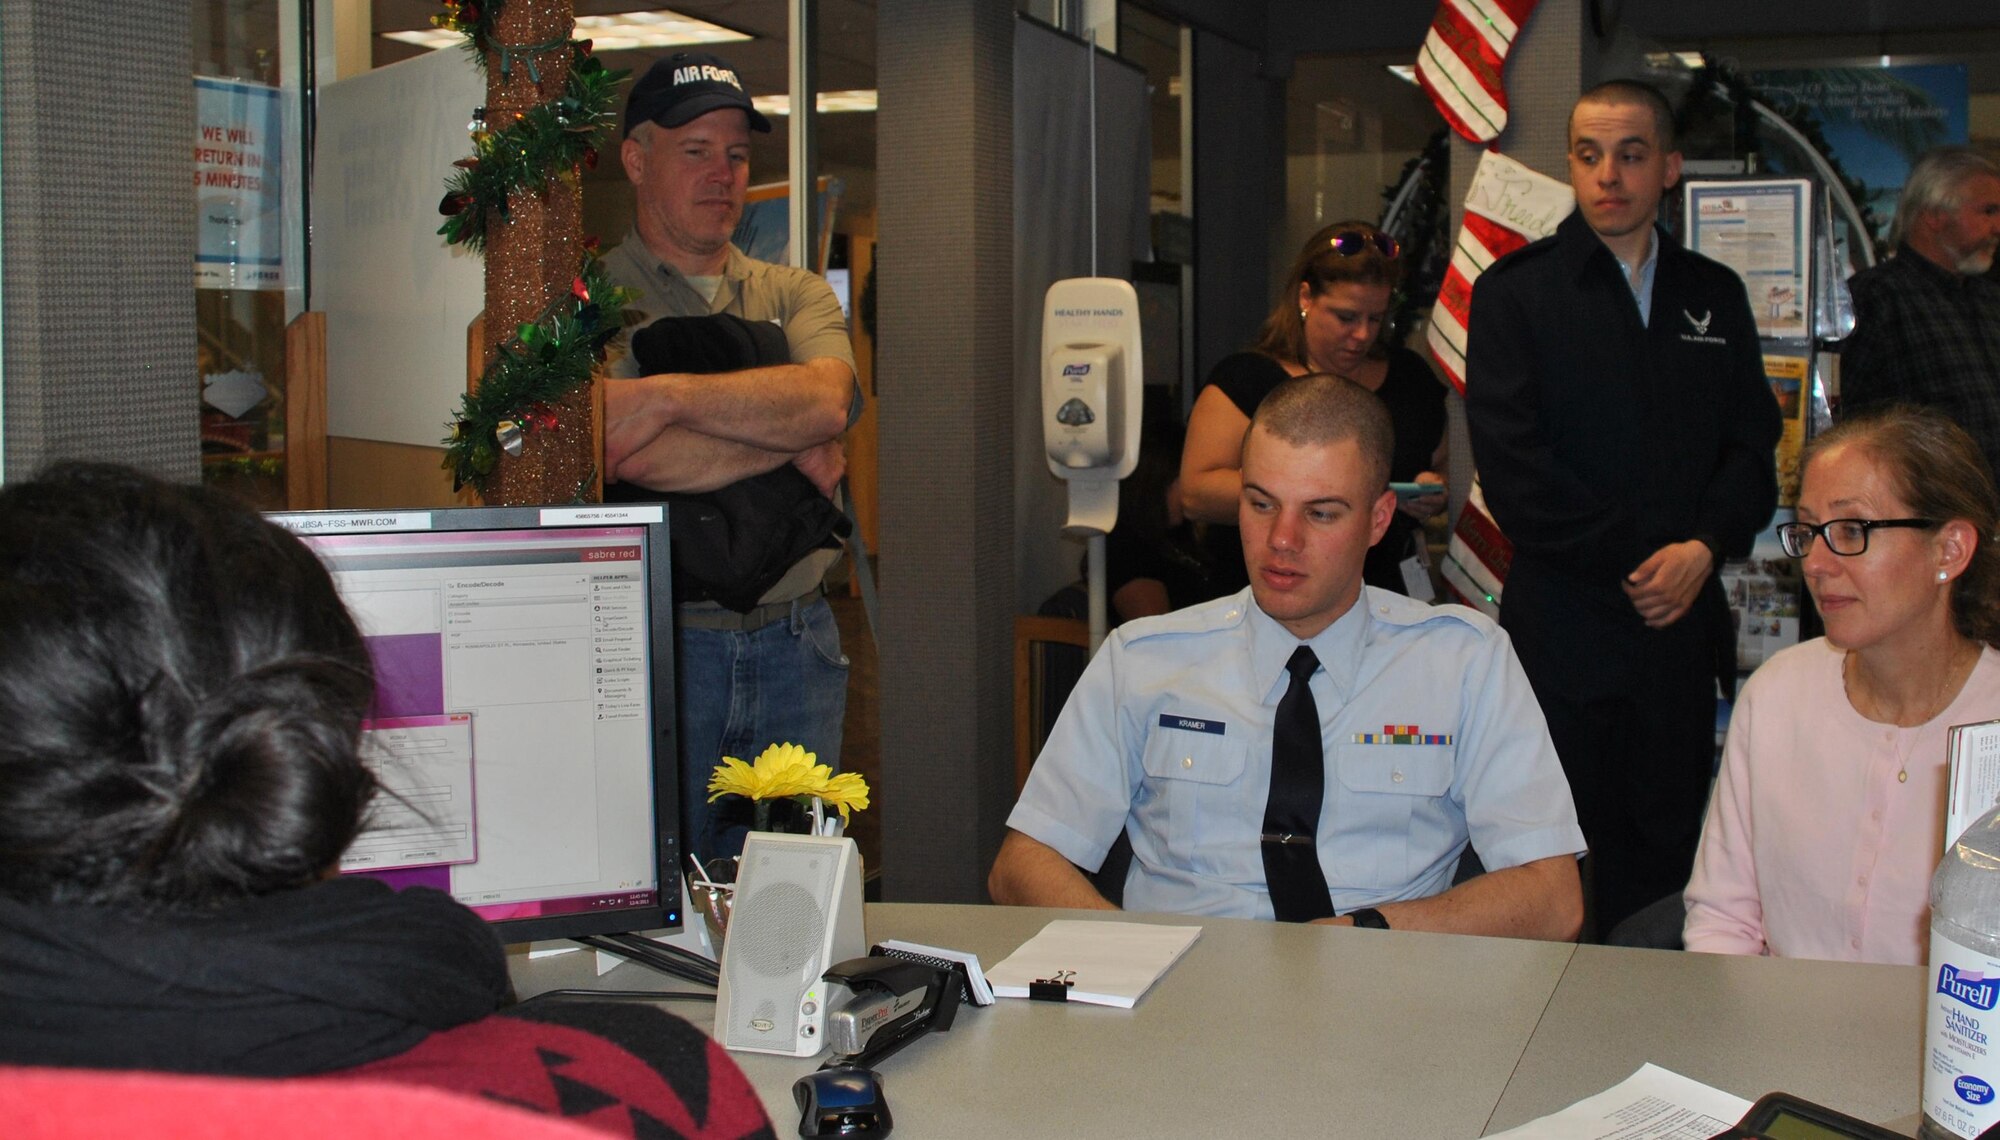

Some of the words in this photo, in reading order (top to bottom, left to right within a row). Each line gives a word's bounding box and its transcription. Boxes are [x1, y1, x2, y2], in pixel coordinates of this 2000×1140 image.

[673, 65, 701, 86] AIR
[701, 65, 743, 92] FORC
[202, 125, 221, 142] WE
[226, 128, 255, 146] WILL
[194, 148, 243, 167] RETURN
[247, 153, 261, 168] IN
[194, 171, 201, 186] 5
[205, 172, 262, 191] MINUTES
[1054, 309, 1090, 317] HEALTHY
[1093, 309, 1123, 317] HANDS
[588, 550, 616, 559] sabre
[619, 549, 636, 558] red
[457, 581, 505, 589] Encode/Decode
[1179, 719, 1206, 730] KRAMER
[1941, 966, 1992, 1008] Purell
[1952, 1007, 1980, 1030] HAND
[1945, 1015, 1988, 1045] SANITIZER
[1949, 1032, 1987, 1056] MOISTURIZERS
[1957, 1078, 1990, 1096] Economy
[1966, 1090, 1981, 1102] Size
[1934, 1105, 1947, 1122] 67.6
[1947, 1113, 1955, 1127] FL
[1957, 1119, 1967, 1133] OZ
